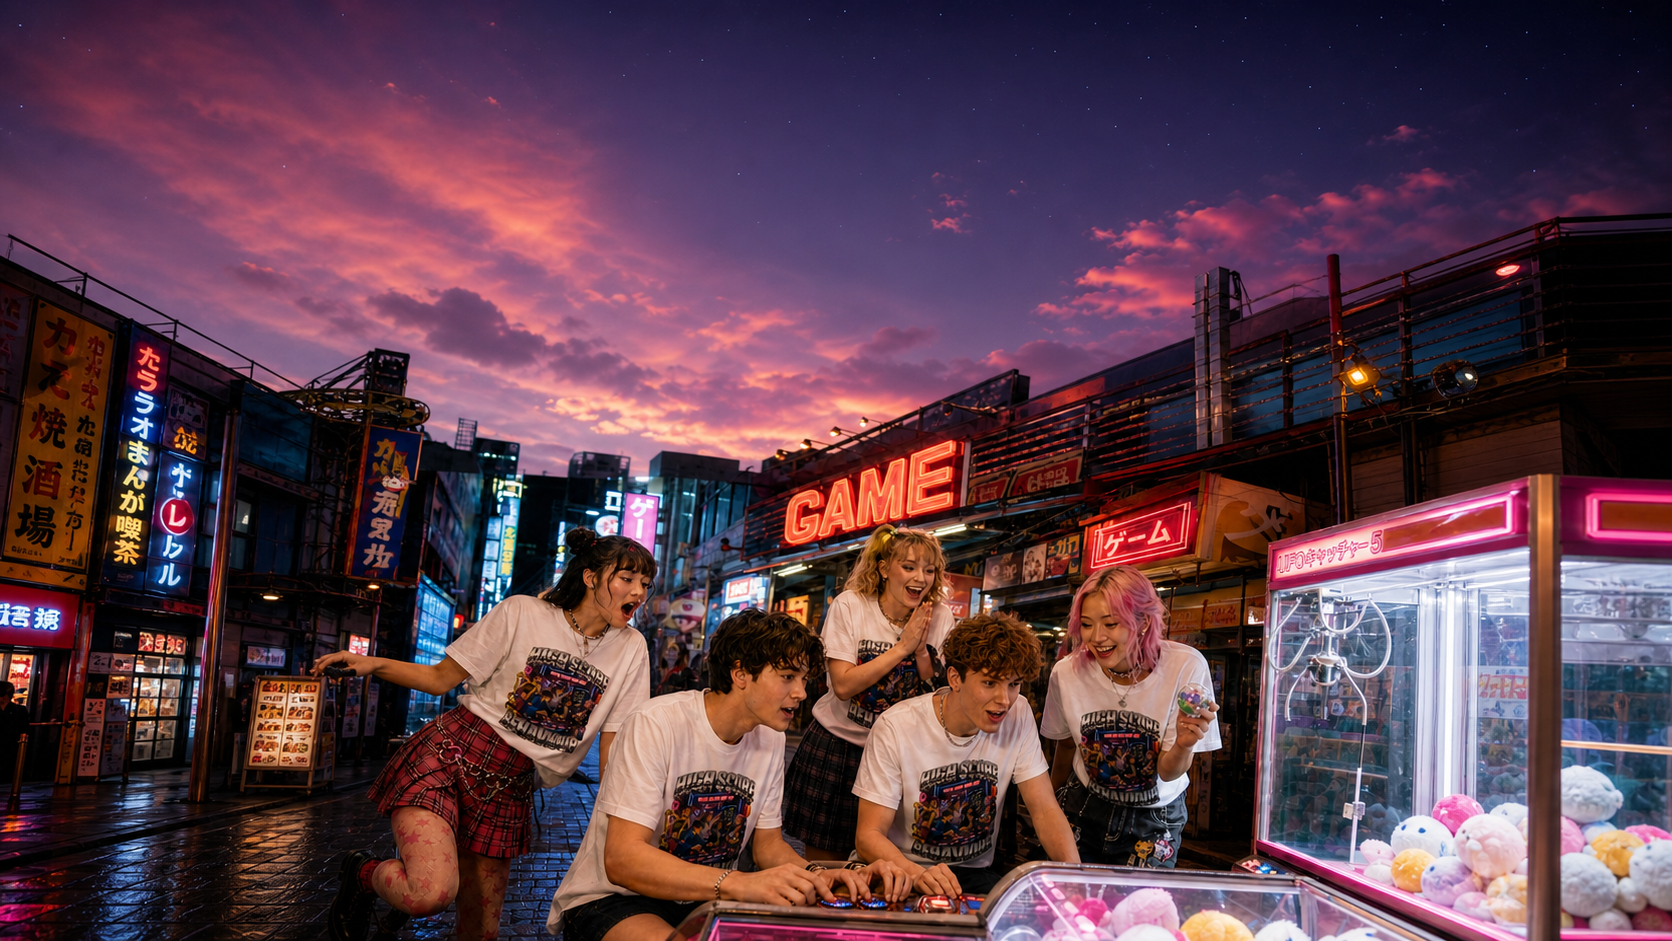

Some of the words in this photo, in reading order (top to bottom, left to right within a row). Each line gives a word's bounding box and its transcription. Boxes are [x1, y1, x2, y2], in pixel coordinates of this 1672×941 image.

[784, 440, 964, 545] GAME
[1103, 519, 1172, 557] ゲーム
